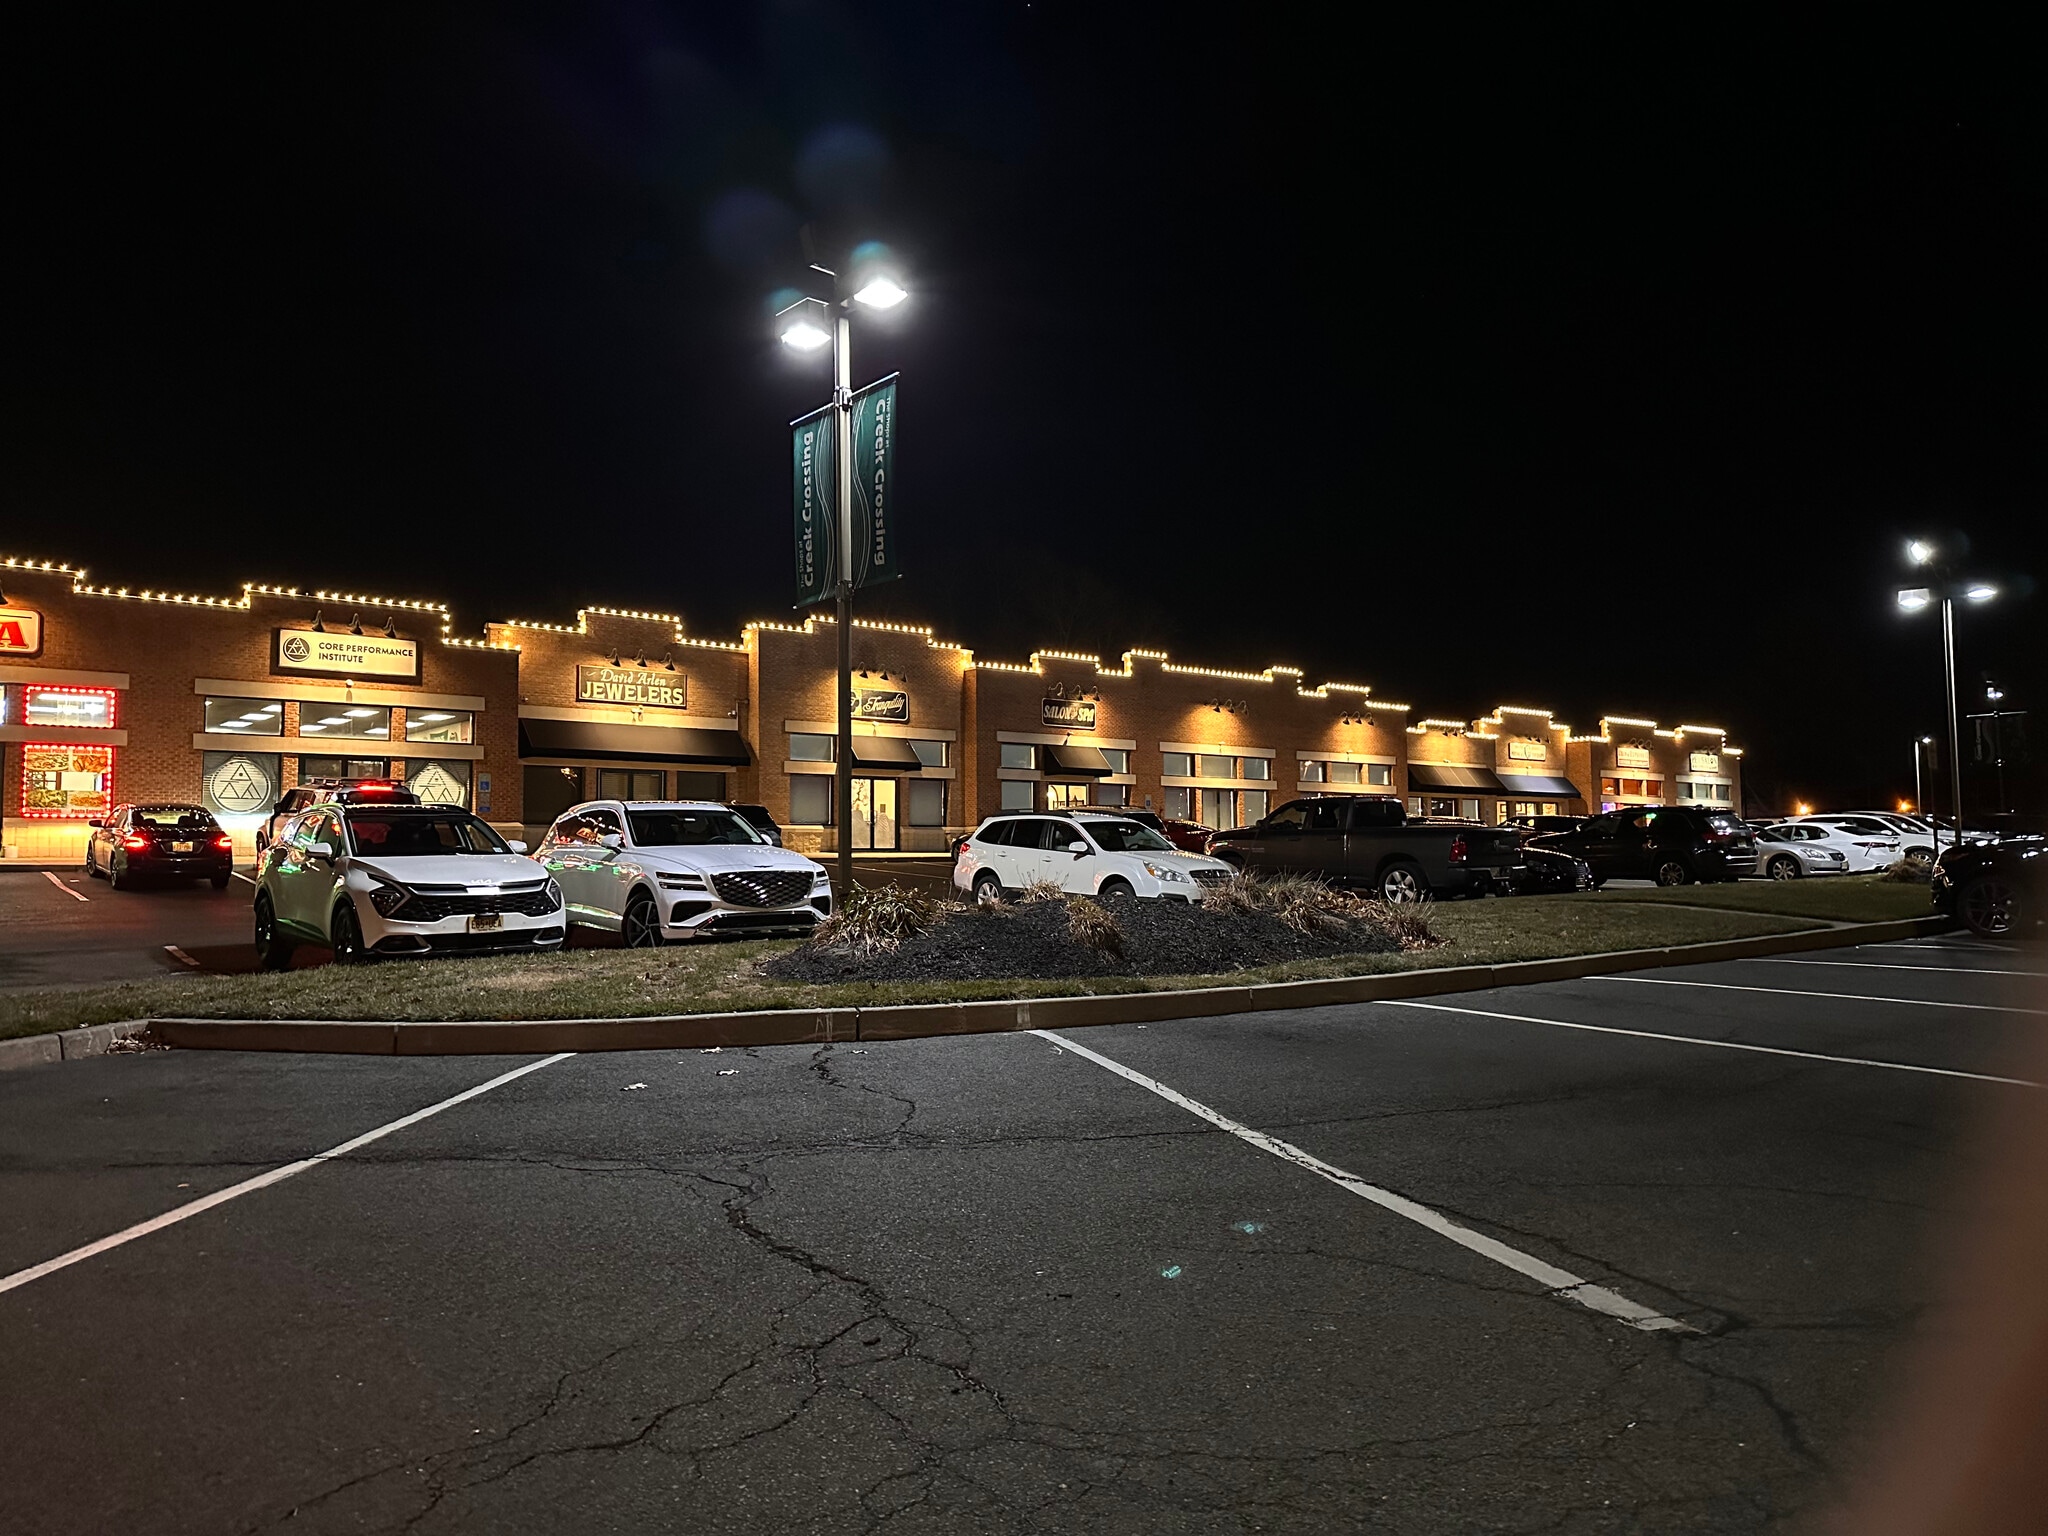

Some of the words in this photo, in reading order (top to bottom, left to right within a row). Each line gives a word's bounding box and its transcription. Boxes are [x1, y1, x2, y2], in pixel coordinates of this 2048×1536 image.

[875, 399, 886, 465] Creek
[802, 431, 814, 522] Crossing
[874, 468, 886, 566] Crossing
[802, 526, 814, 588] Creek
[318, 642, 344, 652] CORE
[346, 644, 414, 657] PERFORMANCE
[318, 652, 364, 663] INSTITUTE
[600, 668, 634, 684] David
[636, 672, 667, 687] Arlen
[581, 681, 684, 705] JEWELERS
[862, 693, 906, 715] Tranquility
[1043, 704, 1071, 720] SALON
[1077, 707, 1095, 722] SPA
